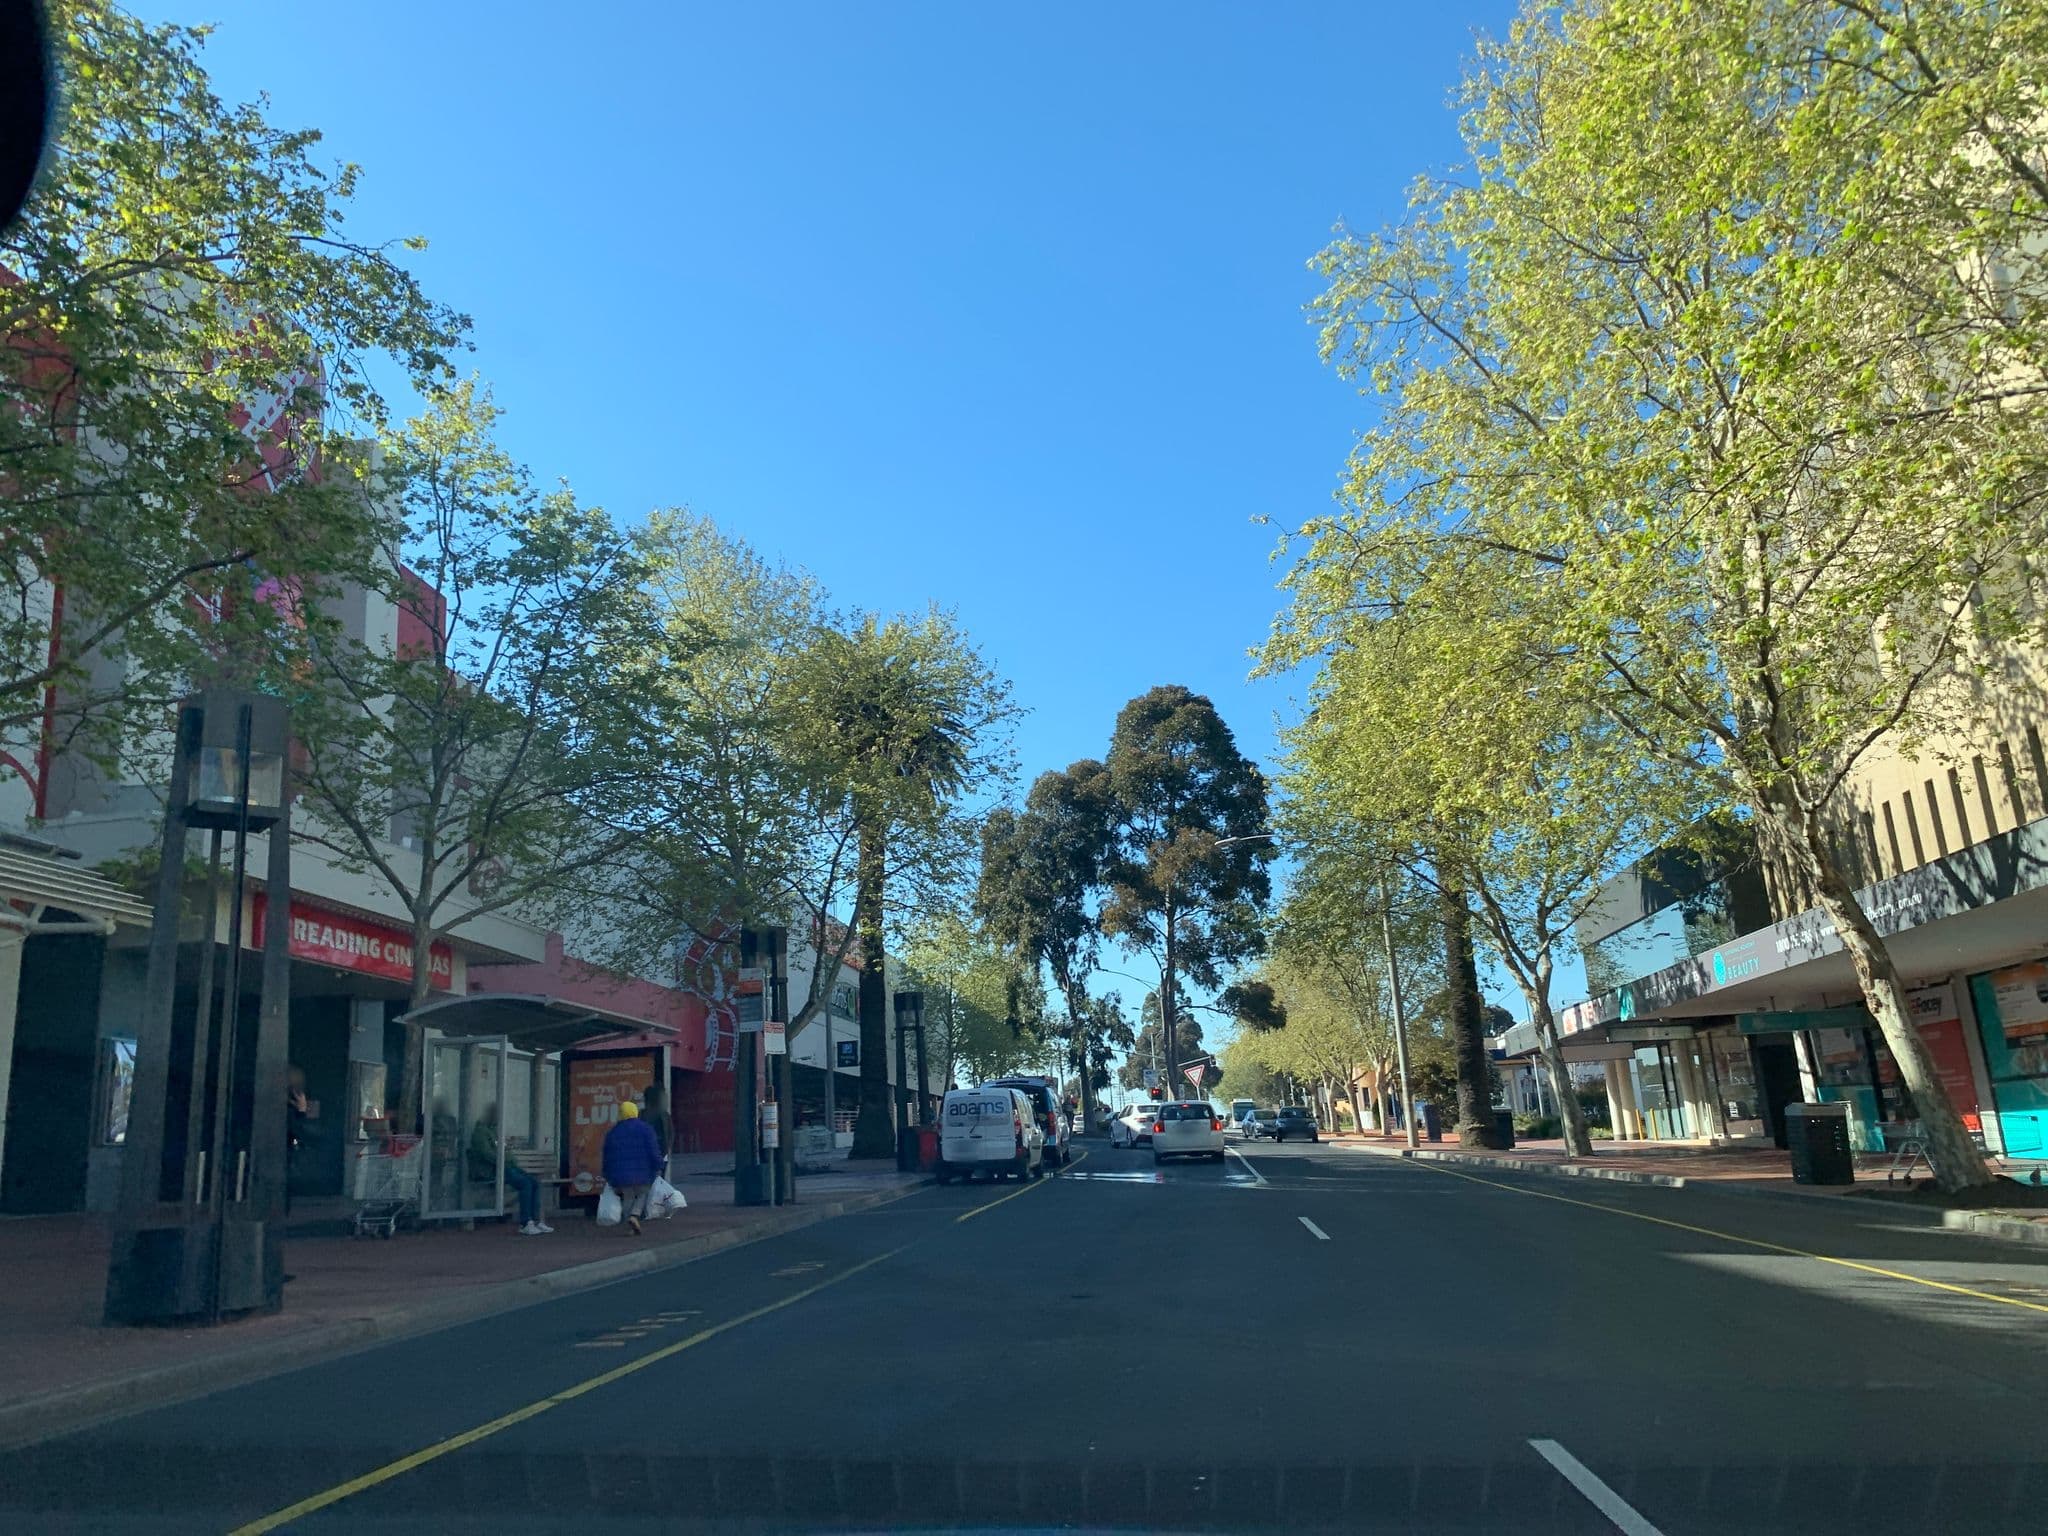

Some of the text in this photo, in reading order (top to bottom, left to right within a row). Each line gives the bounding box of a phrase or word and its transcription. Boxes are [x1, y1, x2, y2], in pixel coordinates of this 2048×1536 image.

[293, 918, 450, 976] READING CINAS
[1727, 957, 1760, 979] BEAUTY
